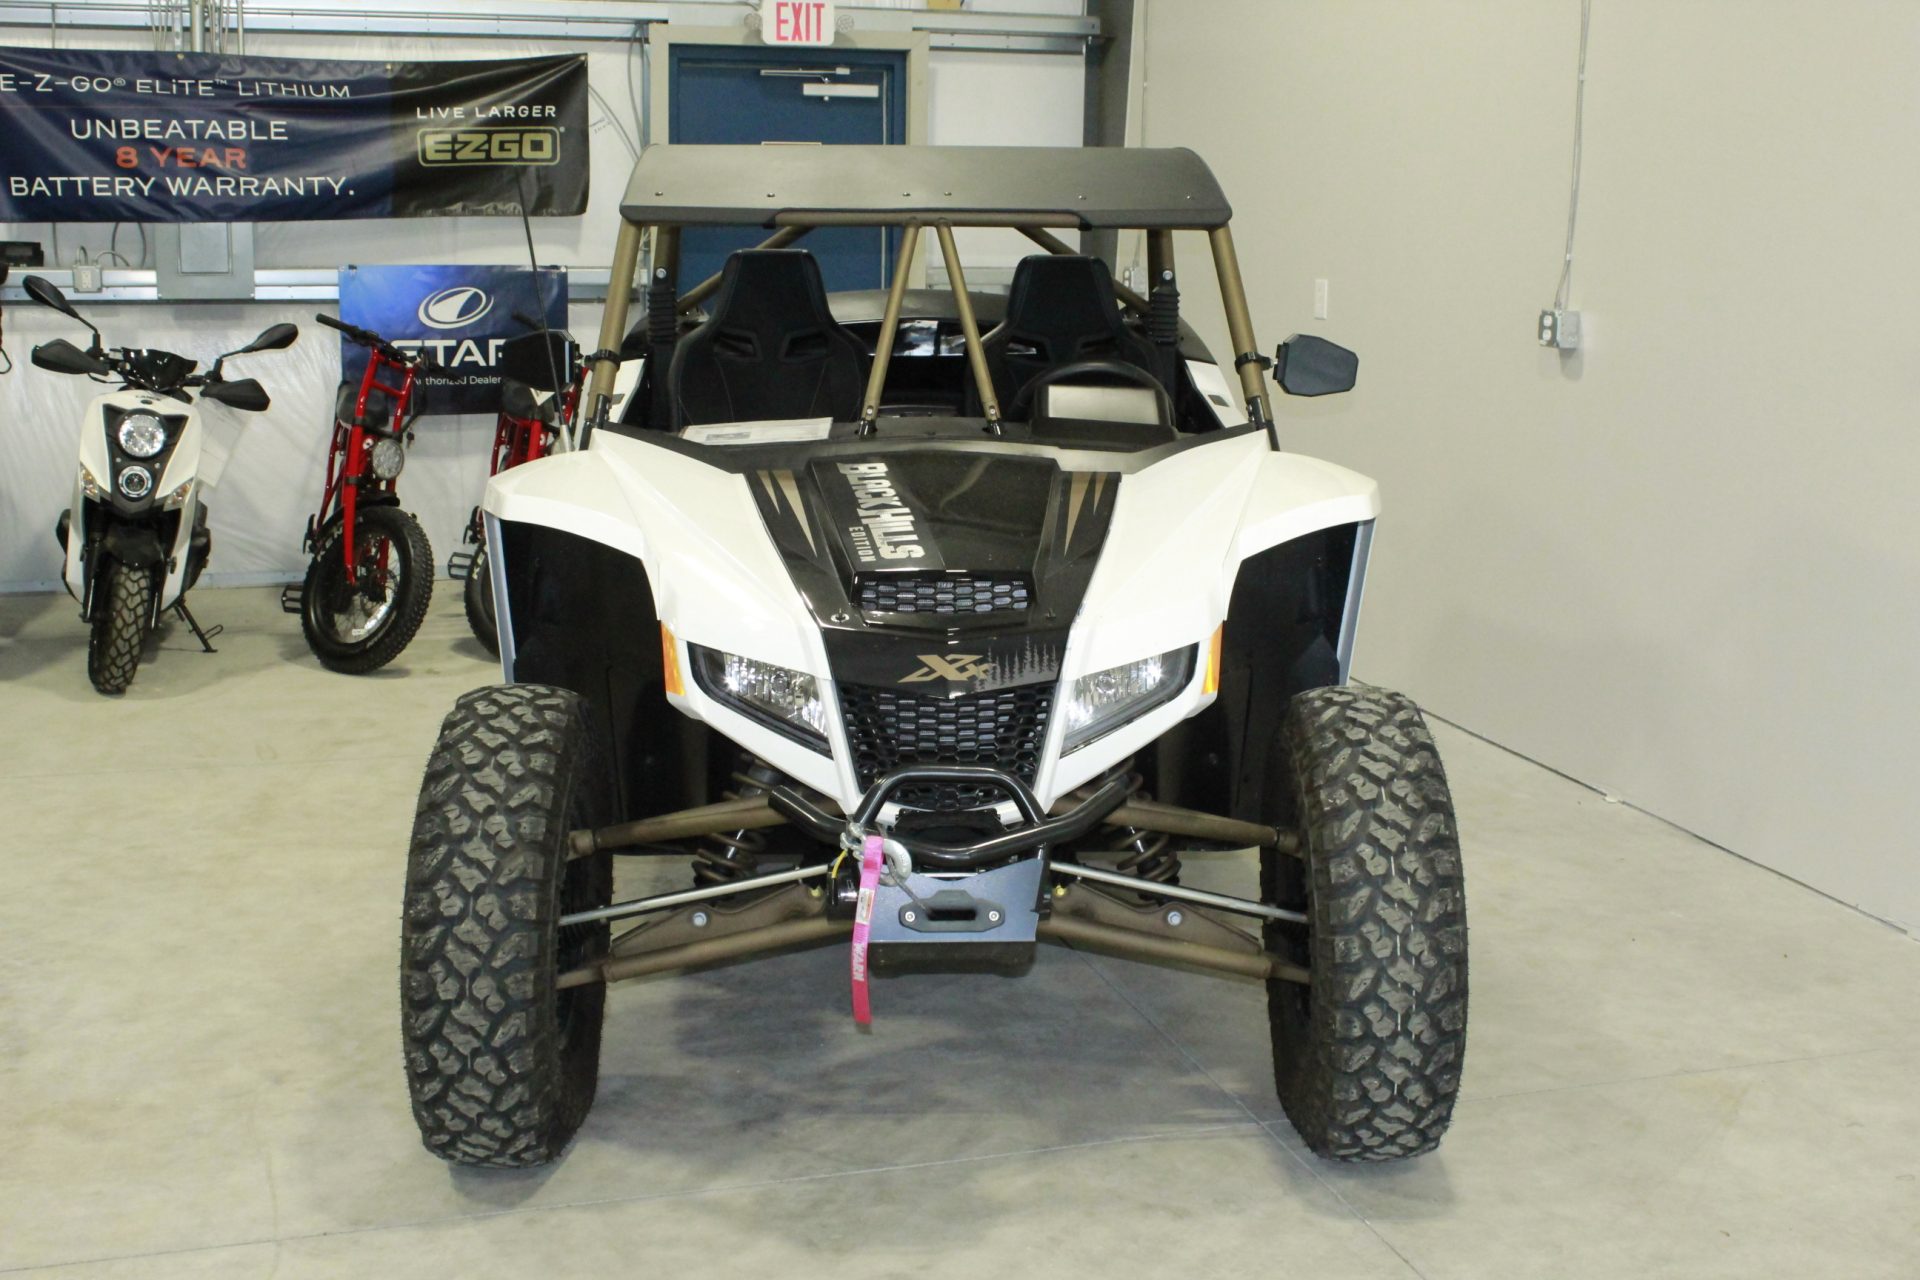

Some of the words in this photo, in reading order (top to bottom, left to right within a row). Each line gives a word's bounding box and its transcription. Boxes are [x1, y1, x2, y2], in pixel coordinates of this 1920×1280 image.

[775, 2, 826, 42] EXIT
[238, 81, 351, 99] LITHIUM
[416, 107, 465, 119] LIVE
[475, 105, 557, 119] LARGER
[71, 119, 289, 141] UNBEATABLE
[115, 145, 139, 170] 8
[150, 146, 247, 170] YEAR
[424, 132, 553, 161] EZGO
[10, 176, 156, 197] BATTERY
[165, 176, 355, 197] WARRANTY.
[469, 375, 502, 385] Dealer
[836, 462, 904, 509] BLACK
[848, 526, 877, 562] EDITION
[856, 506, 926, 560] HILLS
[853, 943, 865, 981] WARN
